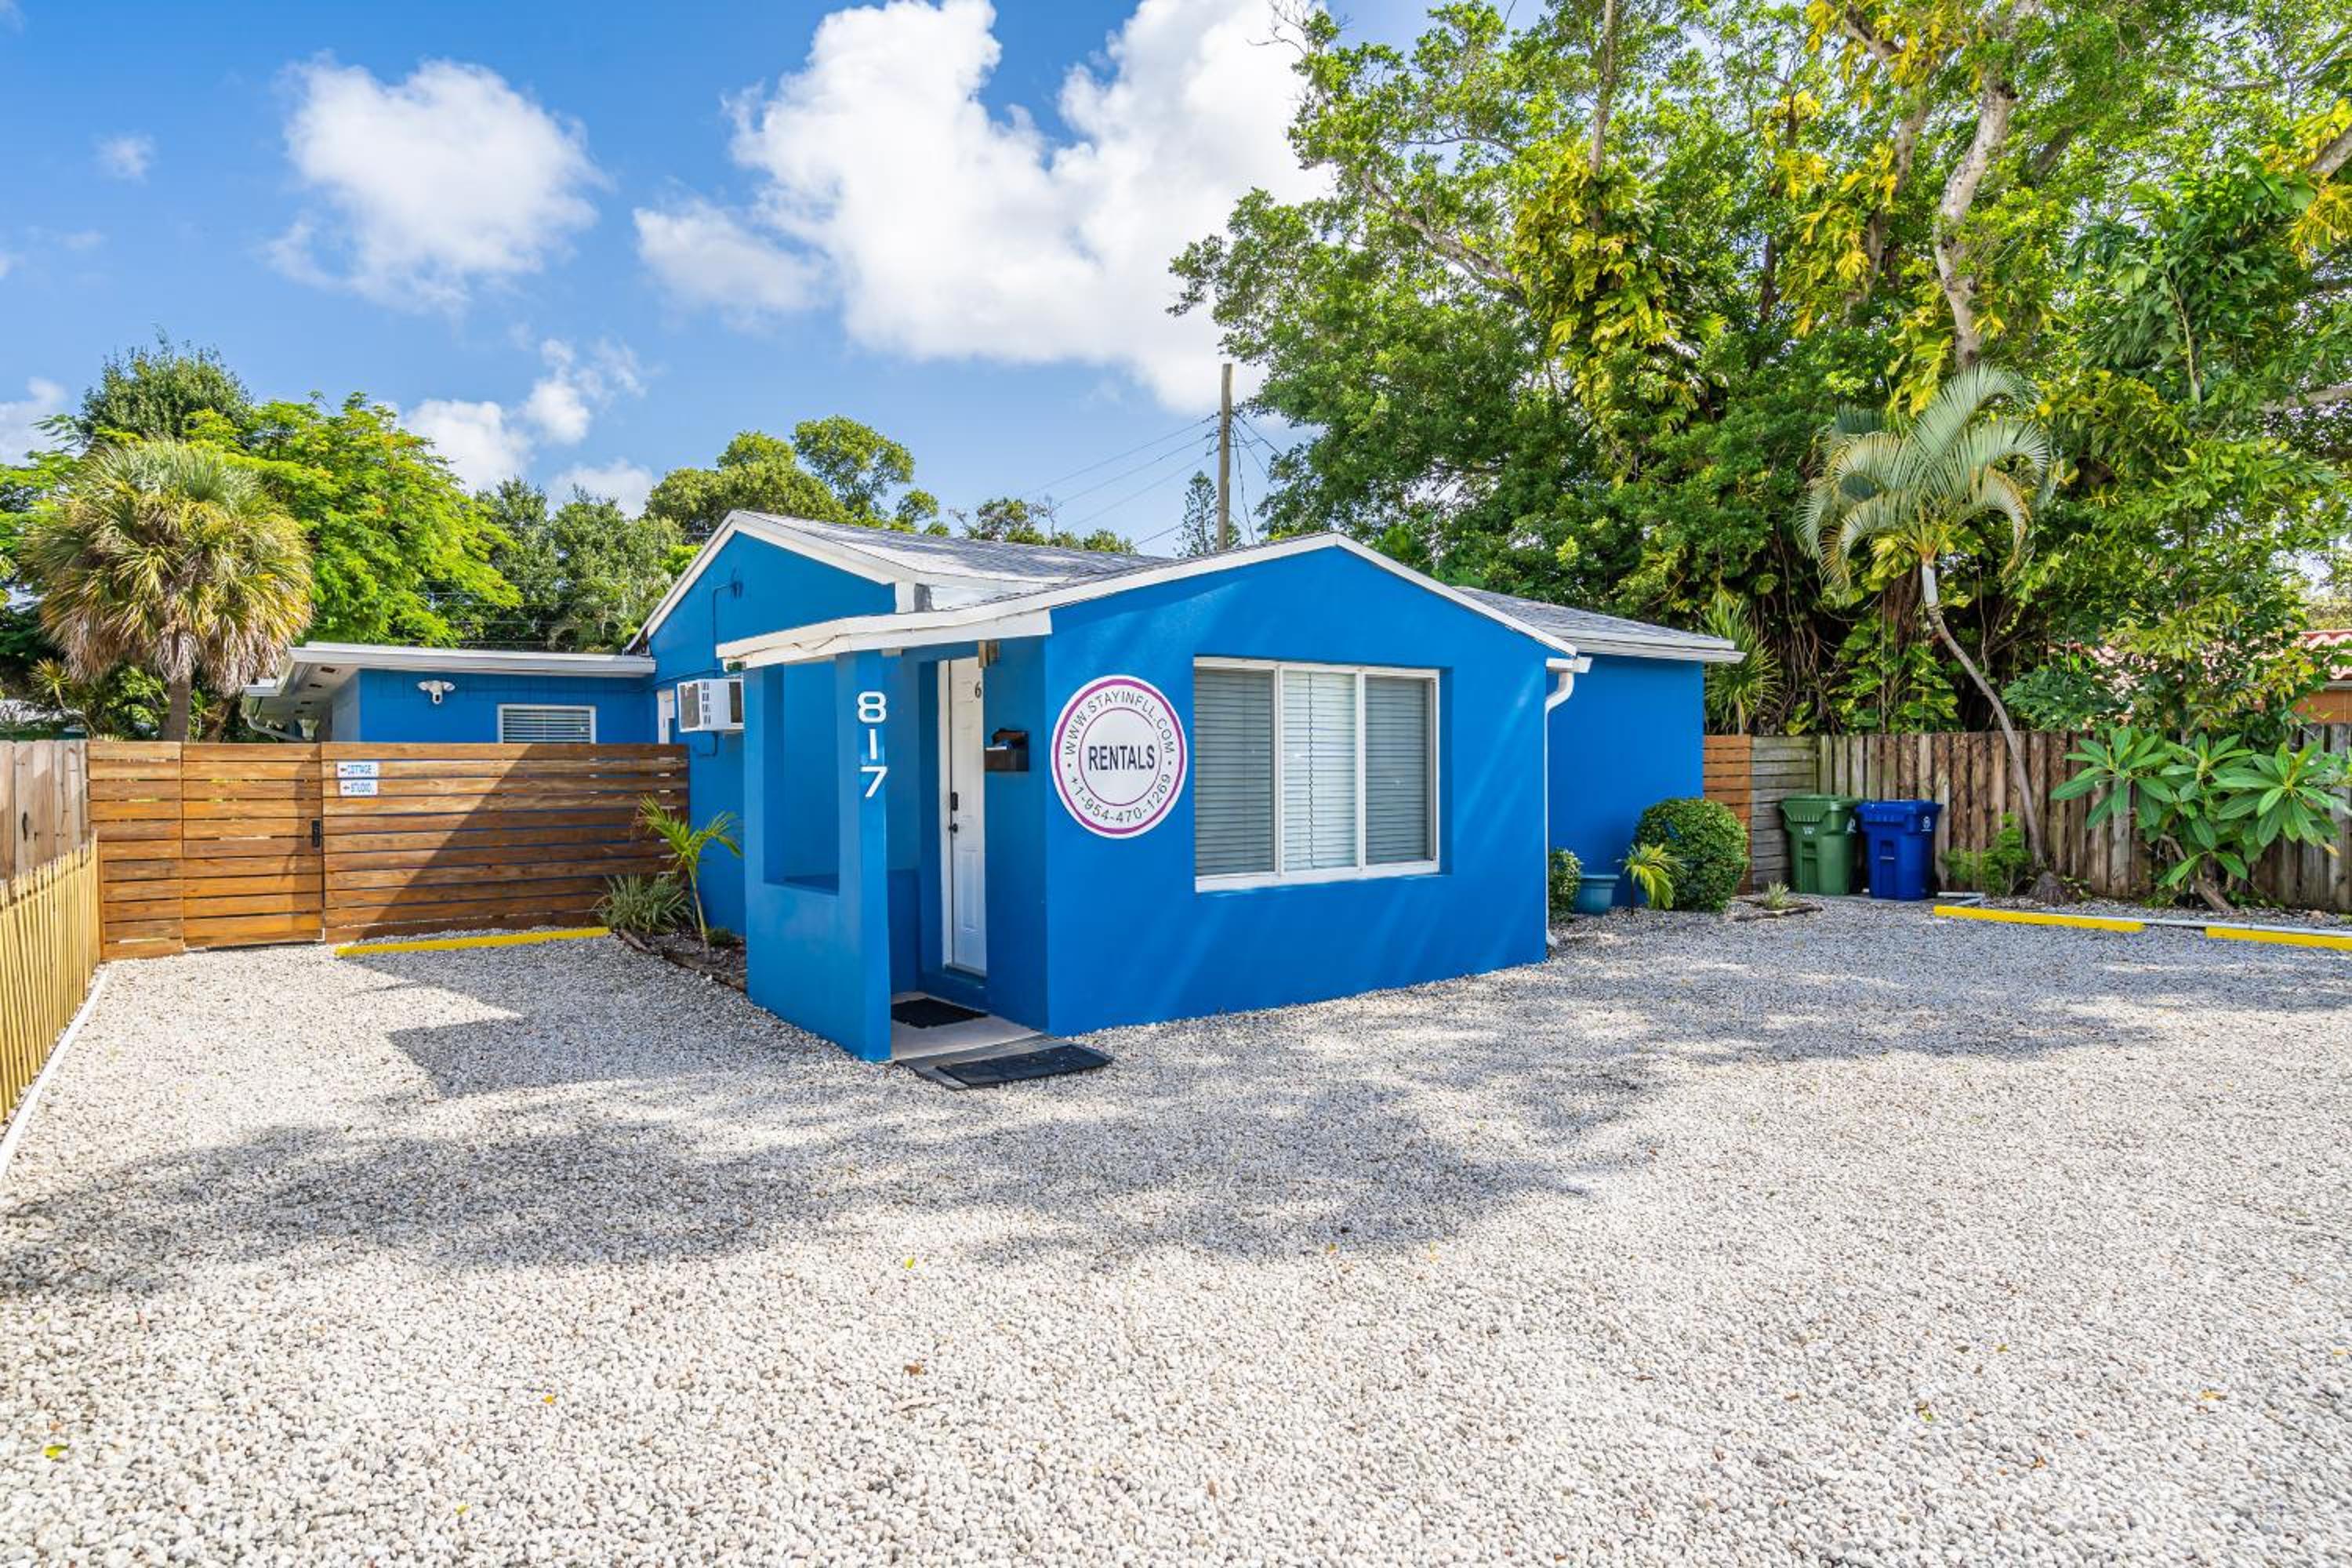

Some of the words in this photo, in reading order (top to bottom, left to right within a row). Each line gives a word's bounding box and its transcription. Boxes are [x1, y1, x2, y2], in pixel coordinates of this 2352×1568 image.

[975, 681, 983, 699] 6
[857, 691, 887, 798] 817
[1065, 690, 1175, 755] WWW.STAYINFLL.COM
[1088, 745, 1155, 771] RENTALS
[1072, 773, 1171, 822] +1-954-470-1269
